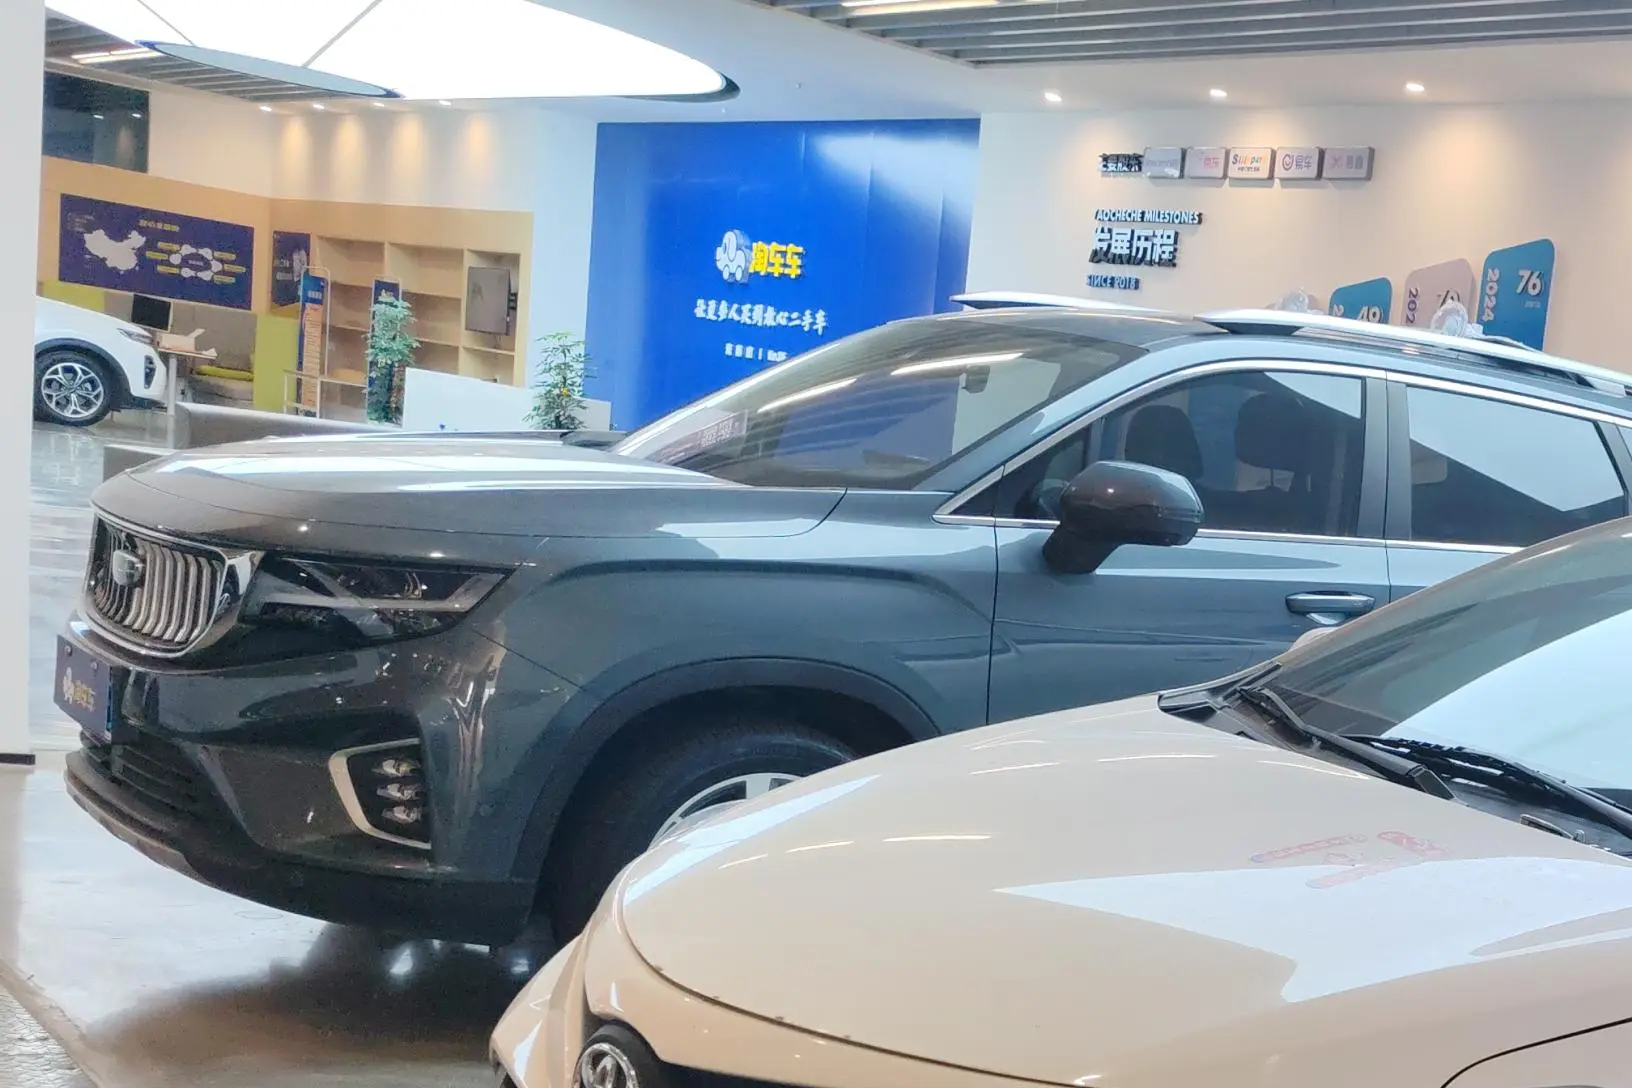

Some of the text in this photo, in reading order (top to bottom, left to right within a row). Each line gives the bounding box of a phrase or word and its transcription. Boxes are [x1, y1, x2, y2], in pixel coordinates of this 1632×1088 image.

[1144, 210, 1201, 225] MILESTONES
[748, 240, 804, 279] 淘车车
[1092, 224, 1178, 266] 发展历程
[1484, 268, 1500, 321] 2024
[1515, 270, 1543, 297] 76
